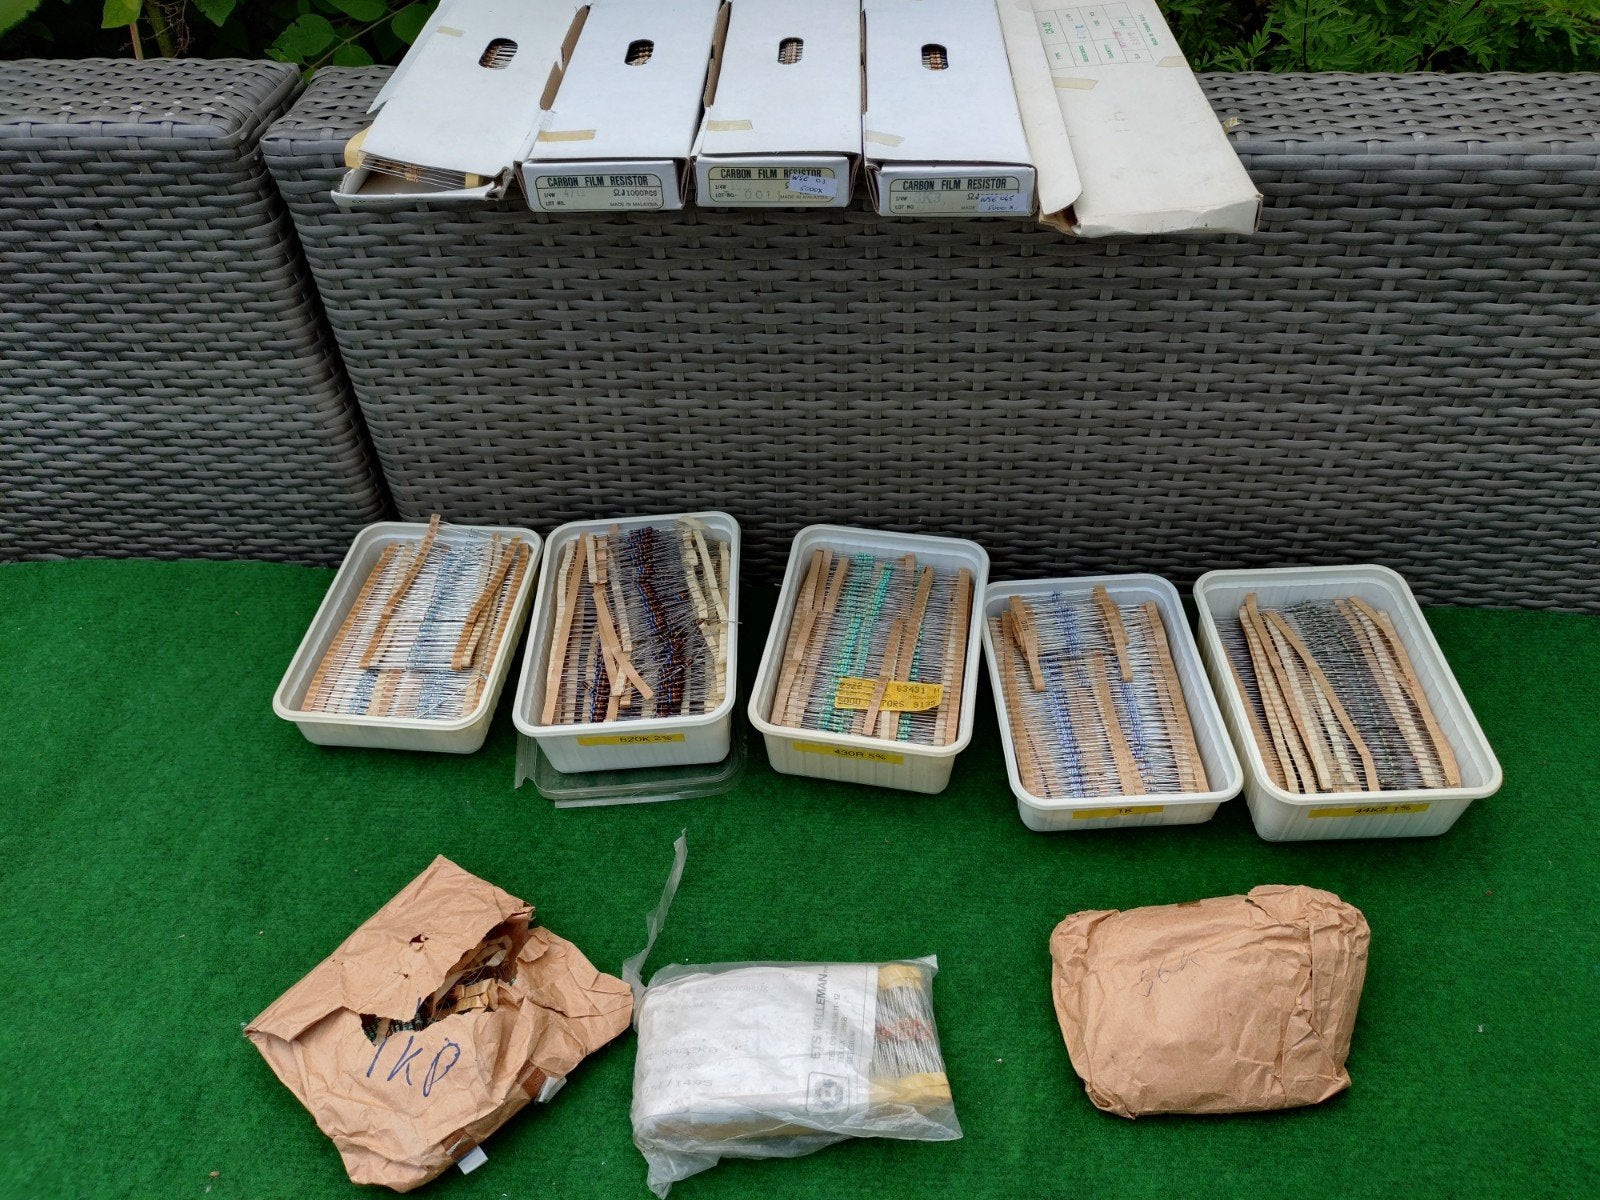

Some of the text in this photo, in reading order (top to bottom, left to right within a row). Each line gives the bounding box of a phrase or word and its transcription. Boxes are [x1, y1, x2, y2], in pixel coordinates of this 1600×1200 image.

[720, 168, 822, 179] CARBON FILM RESISTOR
[547, 175, 649, 187] CARBON FILM RESISTOR
[902, 179, 1007, 190] CARBON FILM RESISTOR
[812, 973, 829, 1031] VELLEMAN
[810, 1036, 822, 1059] ETS
